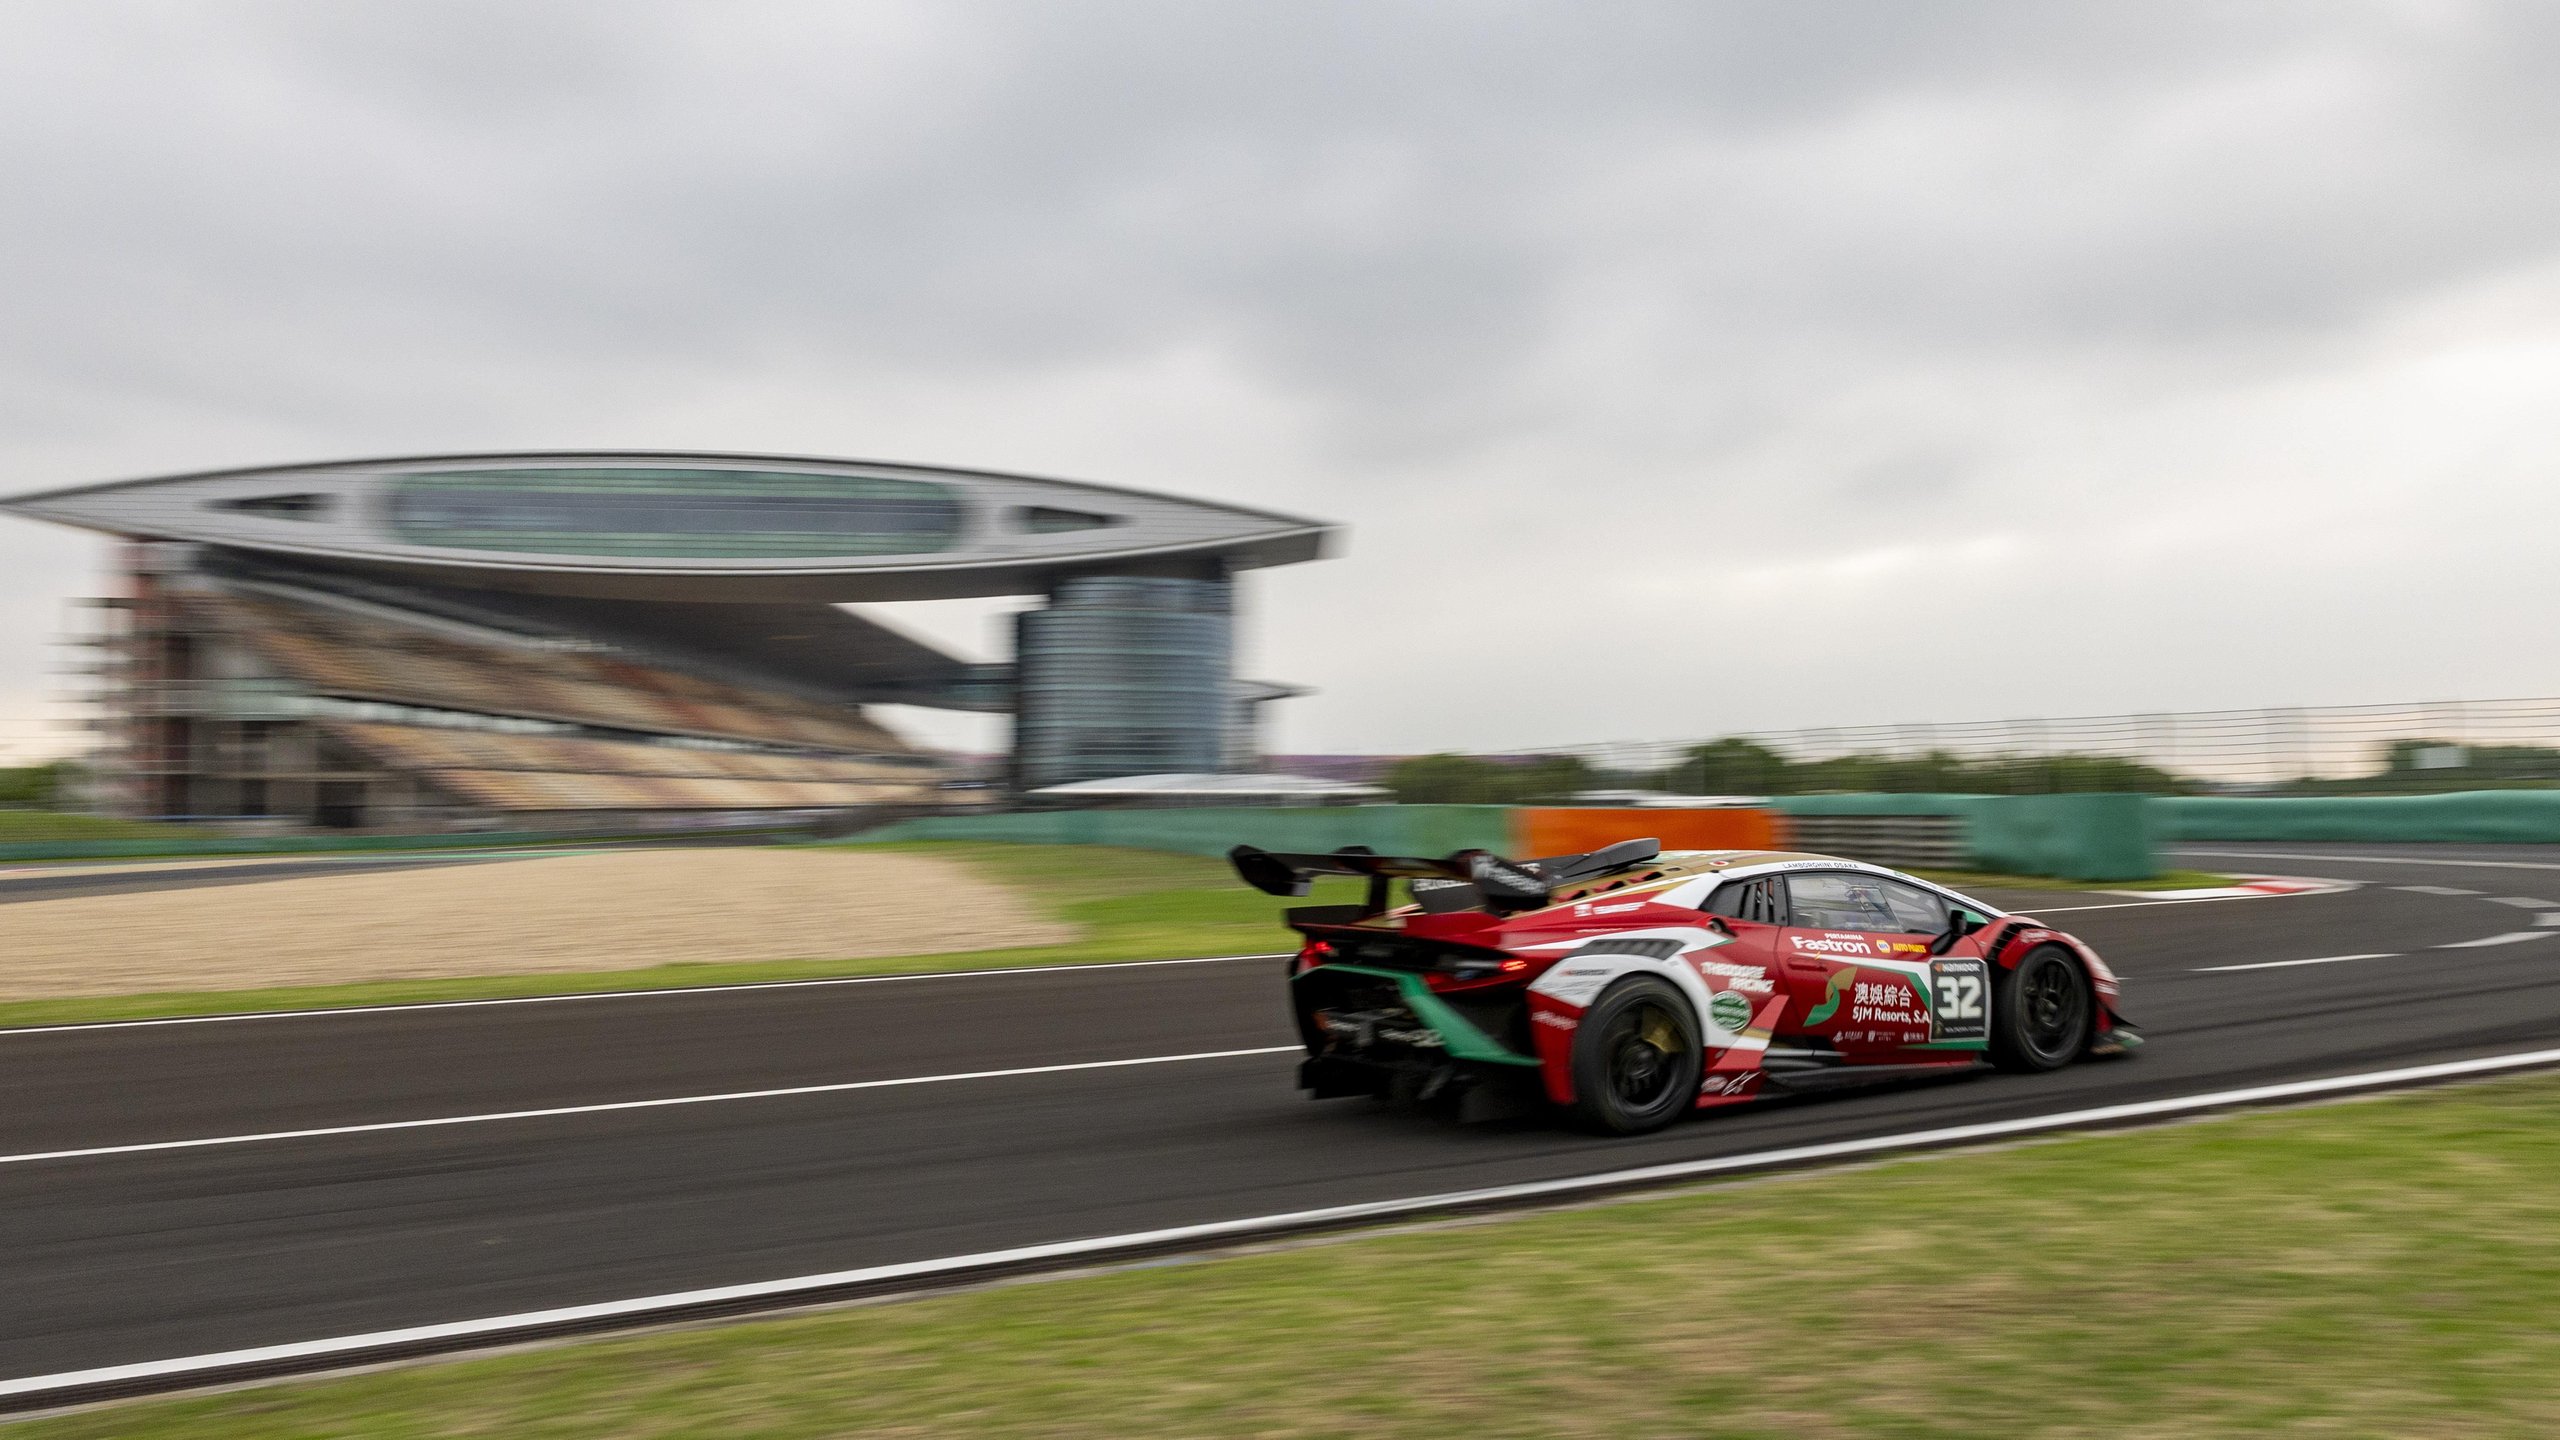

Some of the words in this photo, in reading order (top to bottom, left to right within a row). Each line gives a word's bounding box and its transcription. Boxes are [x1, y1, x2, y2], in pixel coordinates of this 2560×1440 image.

[1790, 936, 1871, 954] Fastron
[1937, 975, 1982, 1019] 32
[1852, 1006, 1872, 1023] SJM
[1874, 1007, 1911, 1025] Resorts,
